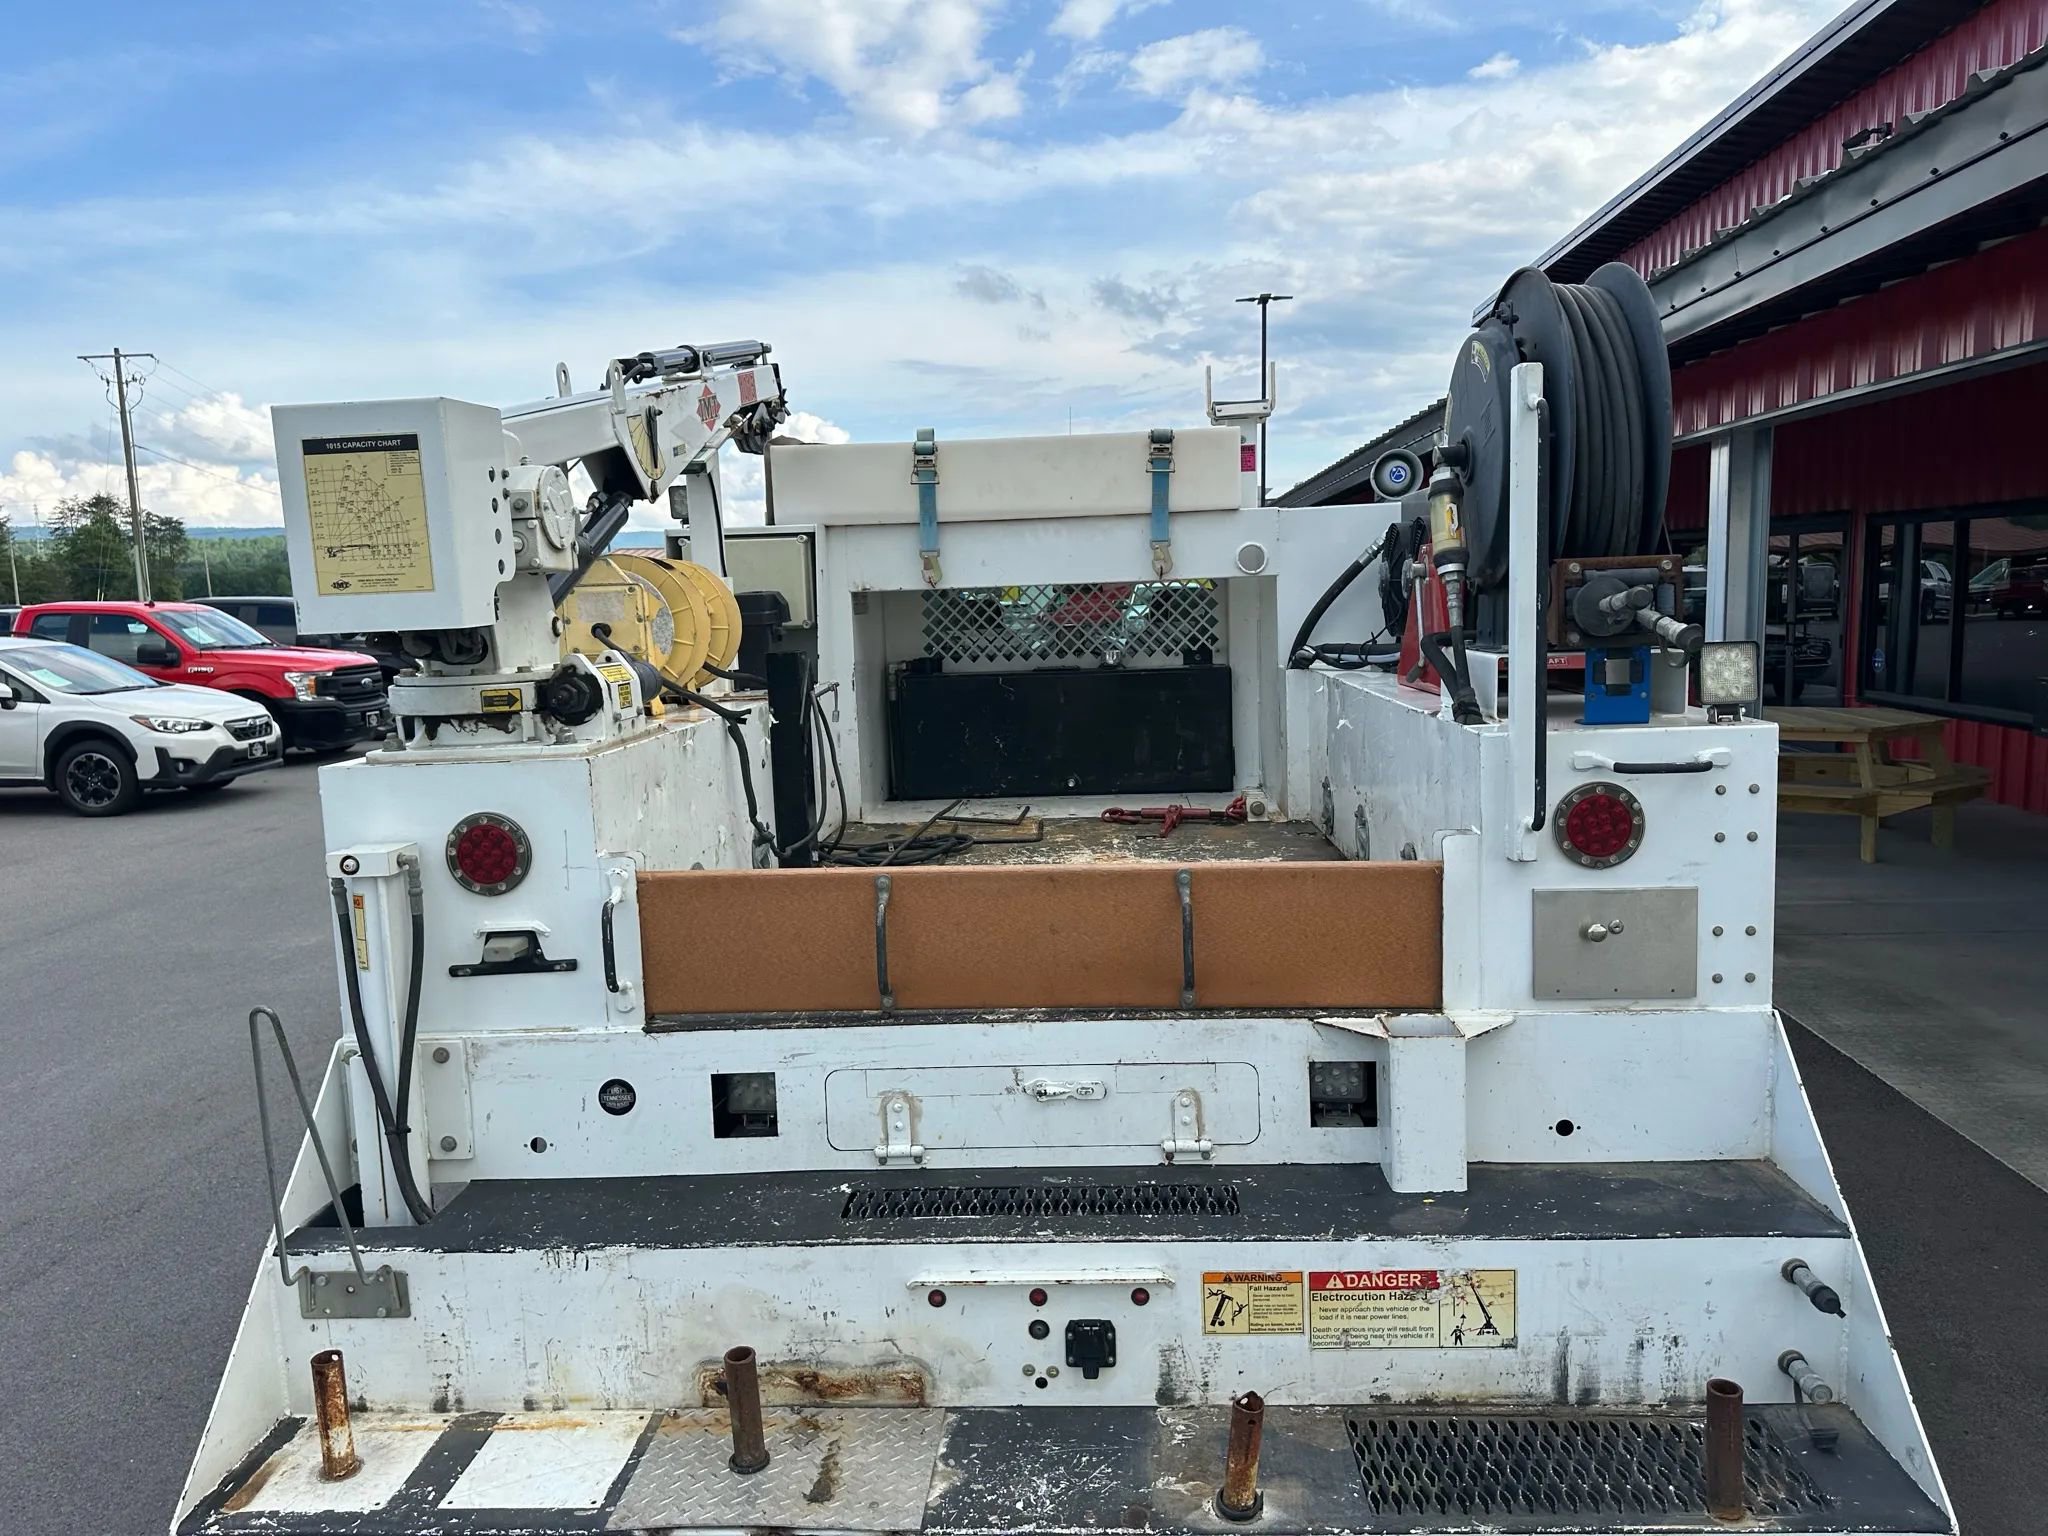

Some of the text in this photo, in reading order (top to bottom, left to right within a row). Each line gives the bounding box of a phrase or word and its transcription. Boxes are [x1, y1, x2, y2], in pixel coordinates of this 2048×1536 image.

[342, 441, 376, 449] CAPACITY
[377, 439, 401, 447] CHART
[1234, 1274, 1283, 1282] WARNING
[1346, 1273, 1422, 1287] DANGER
[1312, 1292, 1386, 1301] Electrocution
